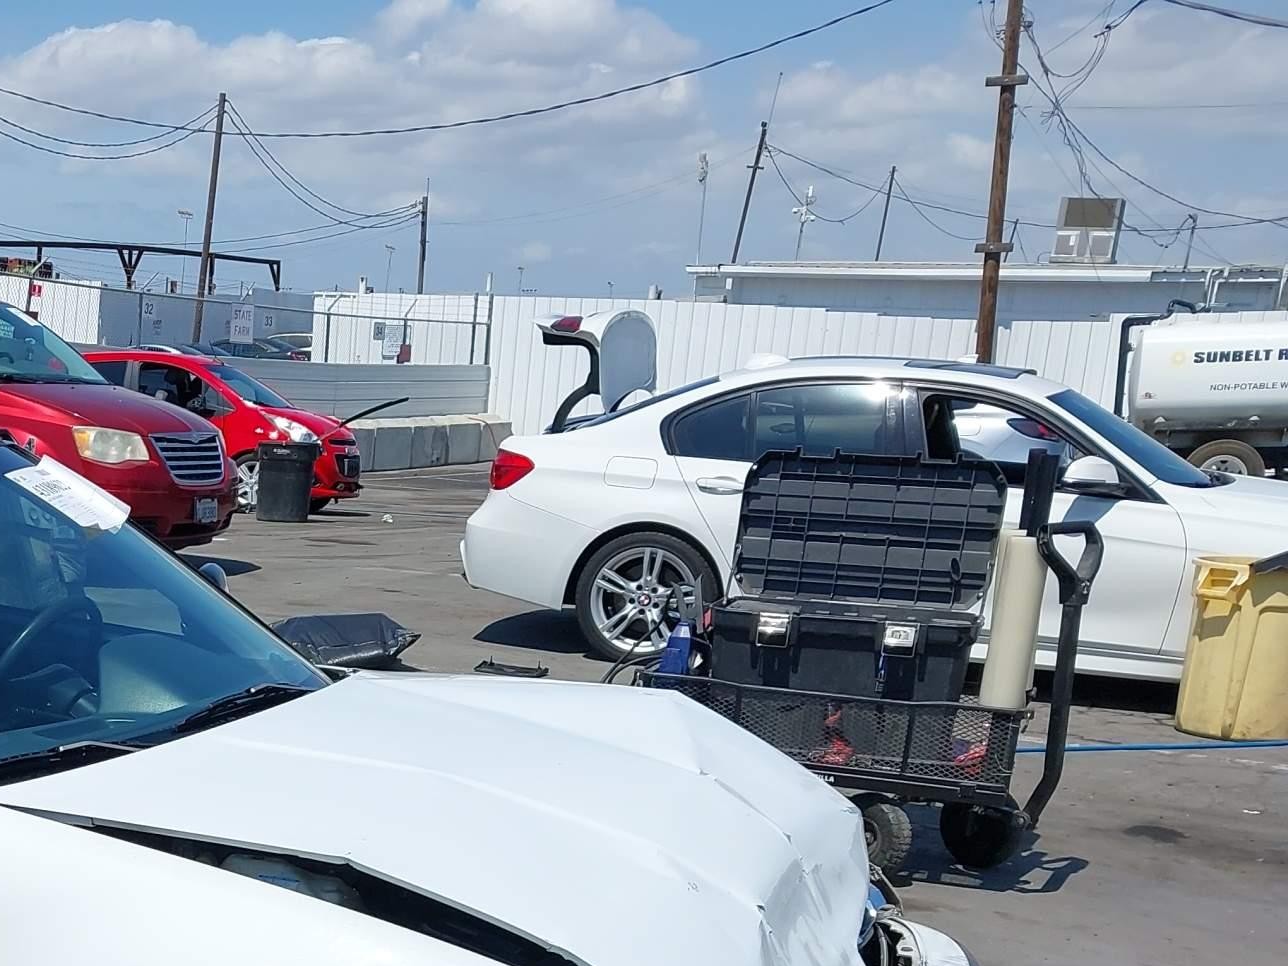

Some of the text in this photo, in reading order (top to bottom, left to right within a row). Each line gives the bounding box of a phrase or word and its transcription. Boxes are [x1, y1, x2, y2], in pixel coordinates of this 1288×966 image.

[144, 302, 154, 315] 32
[234, 309, 252, 321] STATE
[264, 315, 273, 327] 33
[233, 324, 250, 337] FARM
[1193, 349, 1274, 364] SUNBELT
[1210, 382, 1278, 391] NON-POTABLE
